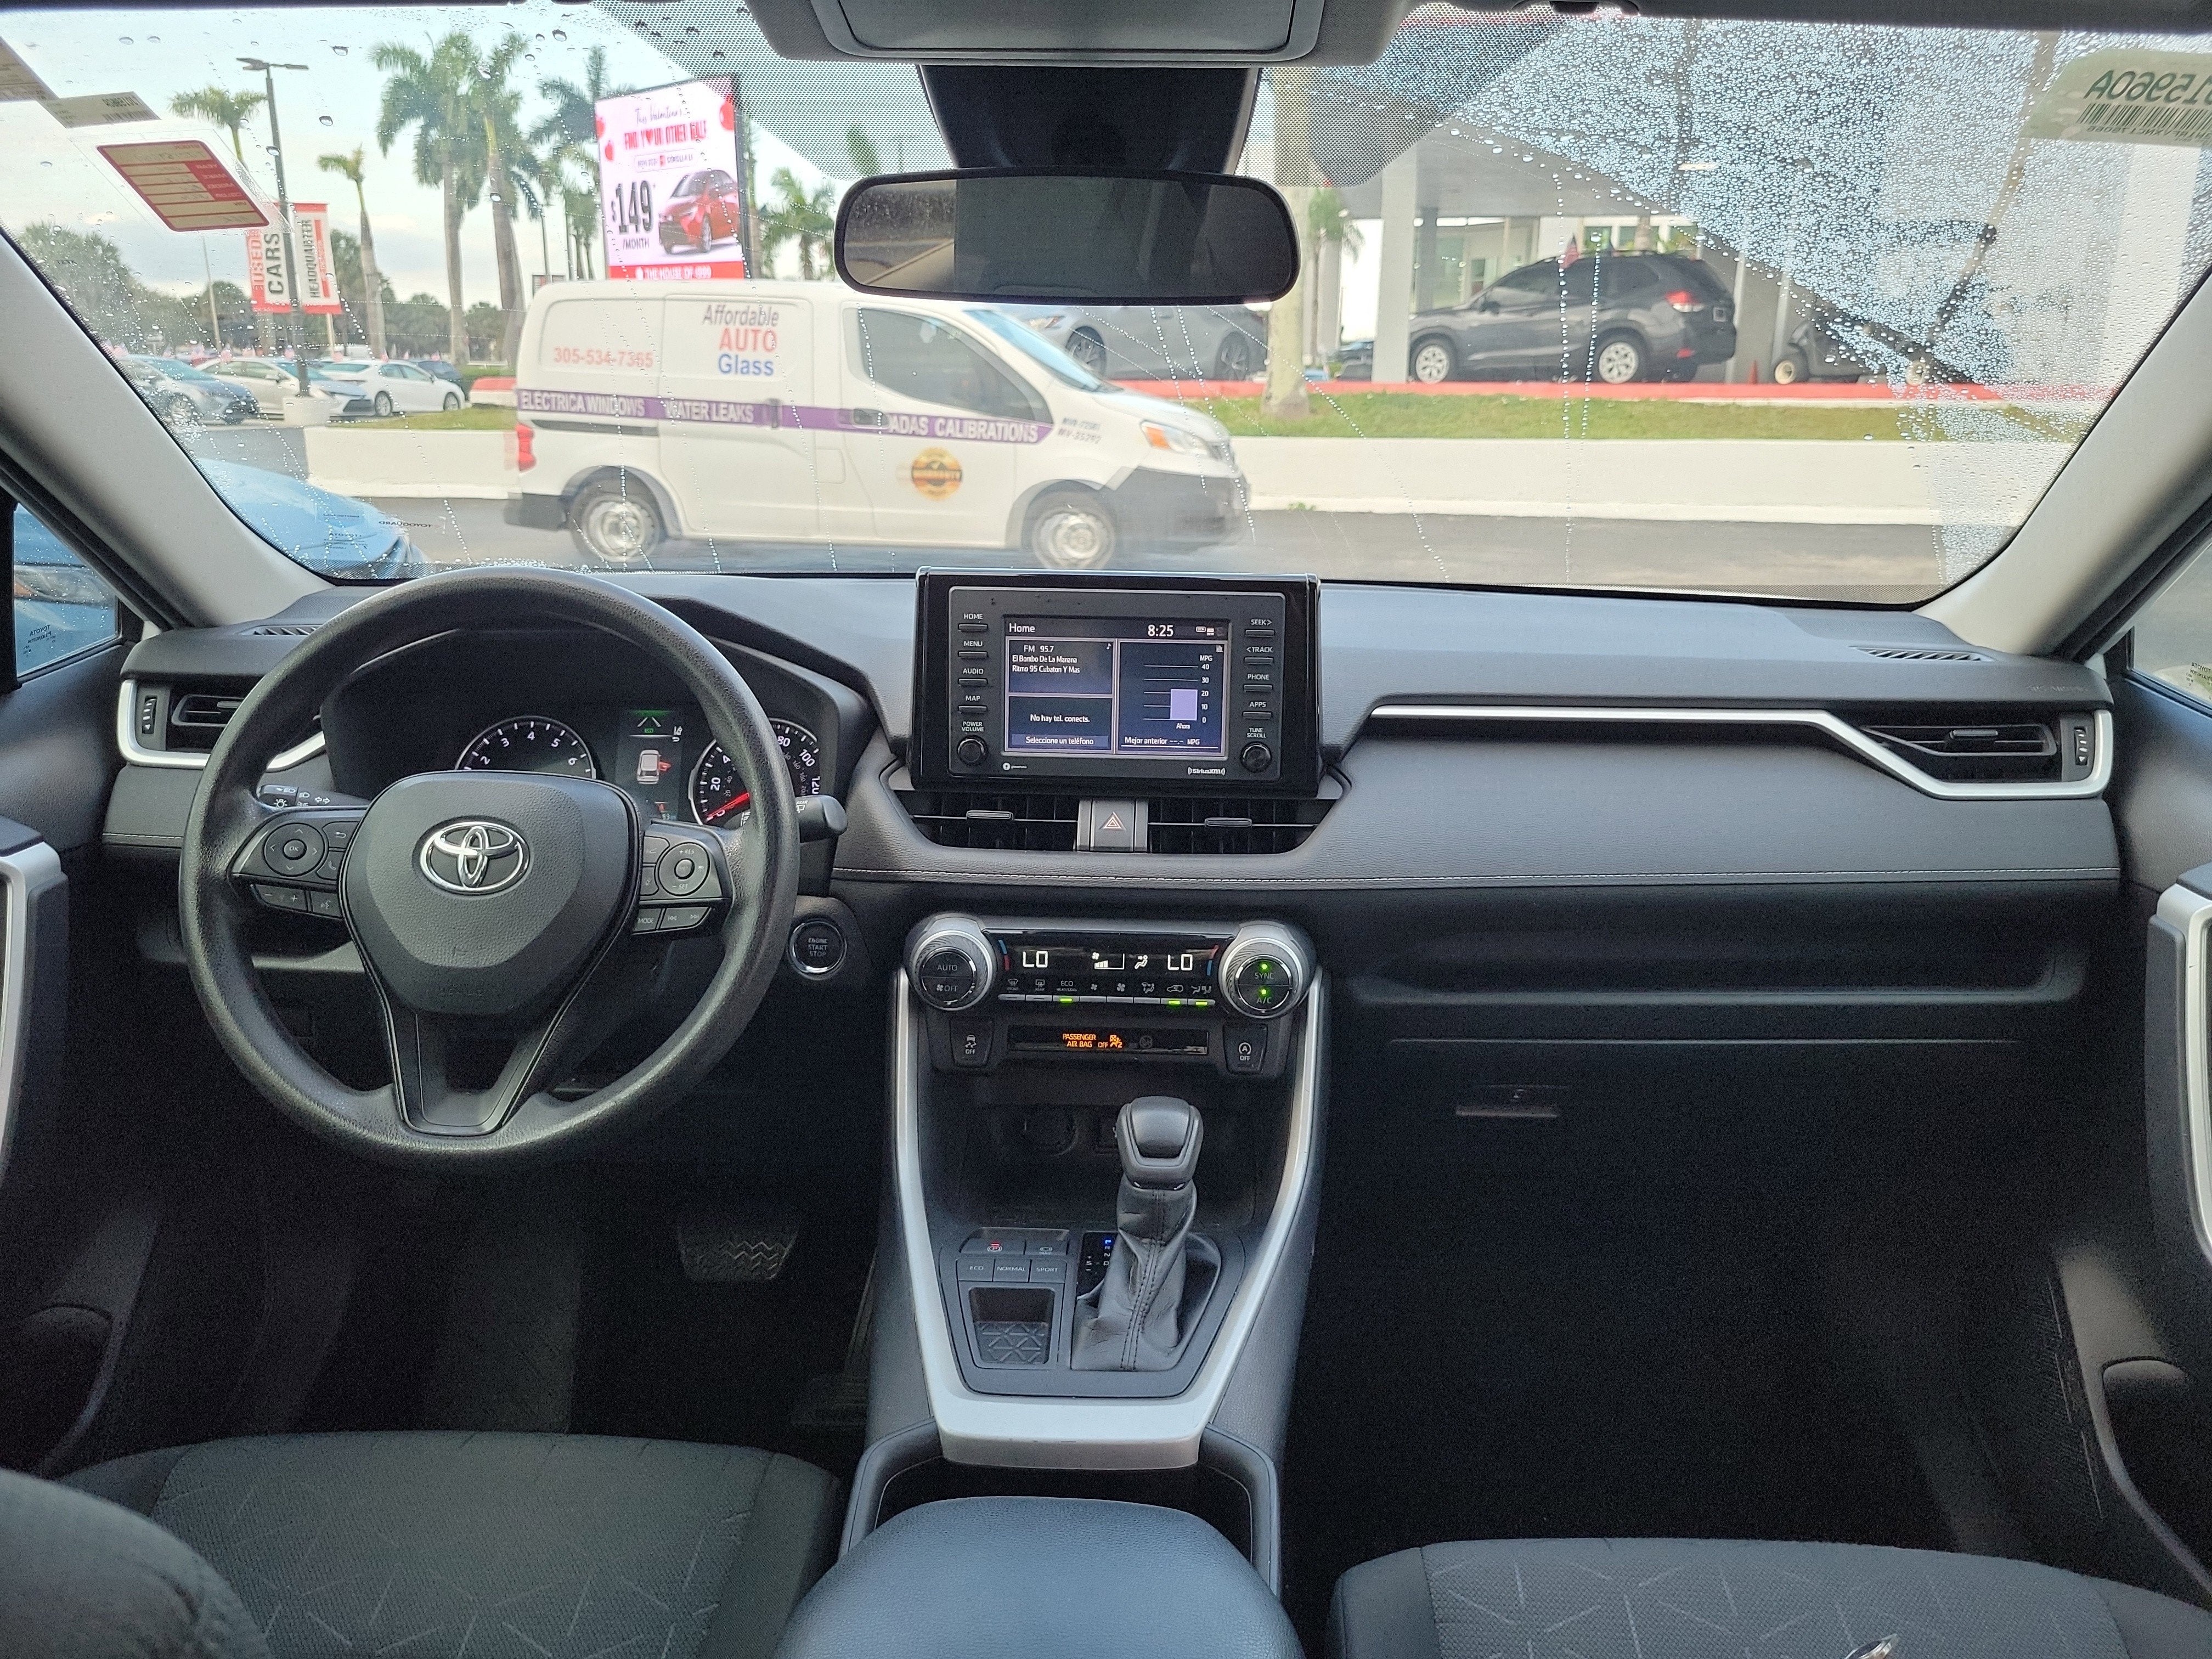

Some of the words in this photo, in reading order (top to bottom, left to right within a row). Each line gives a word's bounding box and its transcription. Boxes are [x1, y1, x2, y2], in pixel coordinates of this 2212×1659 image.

[251, 240, 264, 286] USED
[264, 233, 284, 295] CARS
[702, 304, 779, 326] Affordable
[719, 328, 777, 353] AUTO
[554, 347, 654, 368] 305-534-7365
[718, 354, 774, 376] Glass
[521, 393, 586, 414] ELECTRICA
[586, 396, 645, 417] WINDOWS
[664, 402, 709, 421] WATER
[711, 405, 754, 423] LEAKS
[888, 414, 928, 436] ADAS
[935, 417, 1039, 443] CALIBRATIONS
[1009, 623, 1035, 633] Home
[1148, 624, 1173, 637] 8:25
[1030, 714, 1040, 722] No
[1041, 714, 1053, 723] hay
[1064, 715, 1091, 723] conects.
[501, 738, 510, 747] 3
[527, 731, 535, 741] 4
[551, 738, 561, 748] 5
[777, 736, 791, 747] 80
[1025, 736, 1058, 744] Seleccione
[1125, 736, 1143, 745] Mejor
[480, 755, 490, 765] 2
[568, 758, 578, 766] 6
[799, 748, 815, 767] 100
[710, 777, 721, 791] 20
[1023, 951, 1048, 967] LO
[1167, 954, 1193, 970] LO
